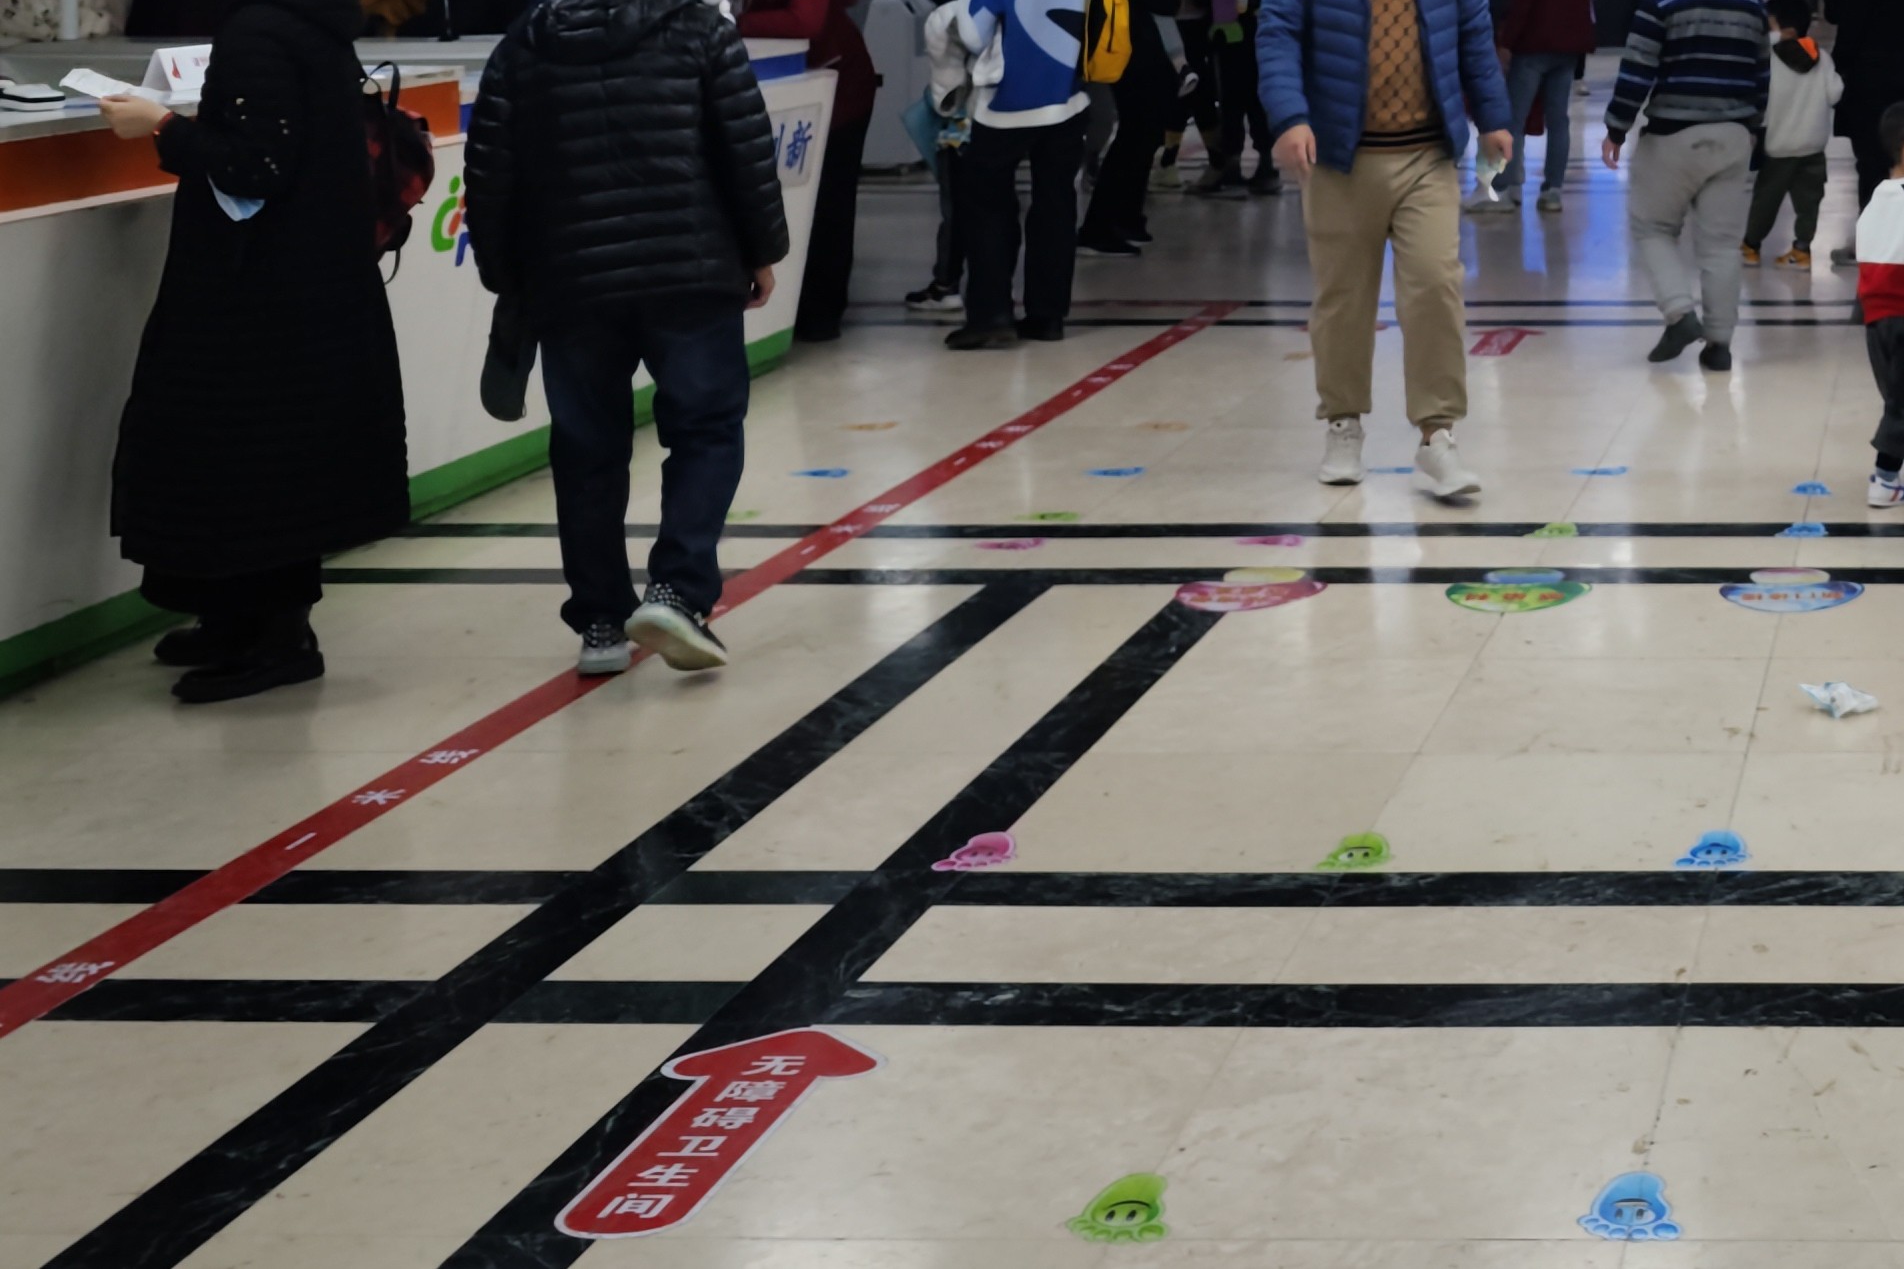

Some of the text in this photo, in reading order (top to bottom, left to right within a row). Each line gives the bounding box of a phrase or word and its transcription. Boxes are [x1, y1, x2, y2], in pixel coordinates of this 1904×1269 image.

[595, 1054, 808, 1221] 无障碍卫生间
